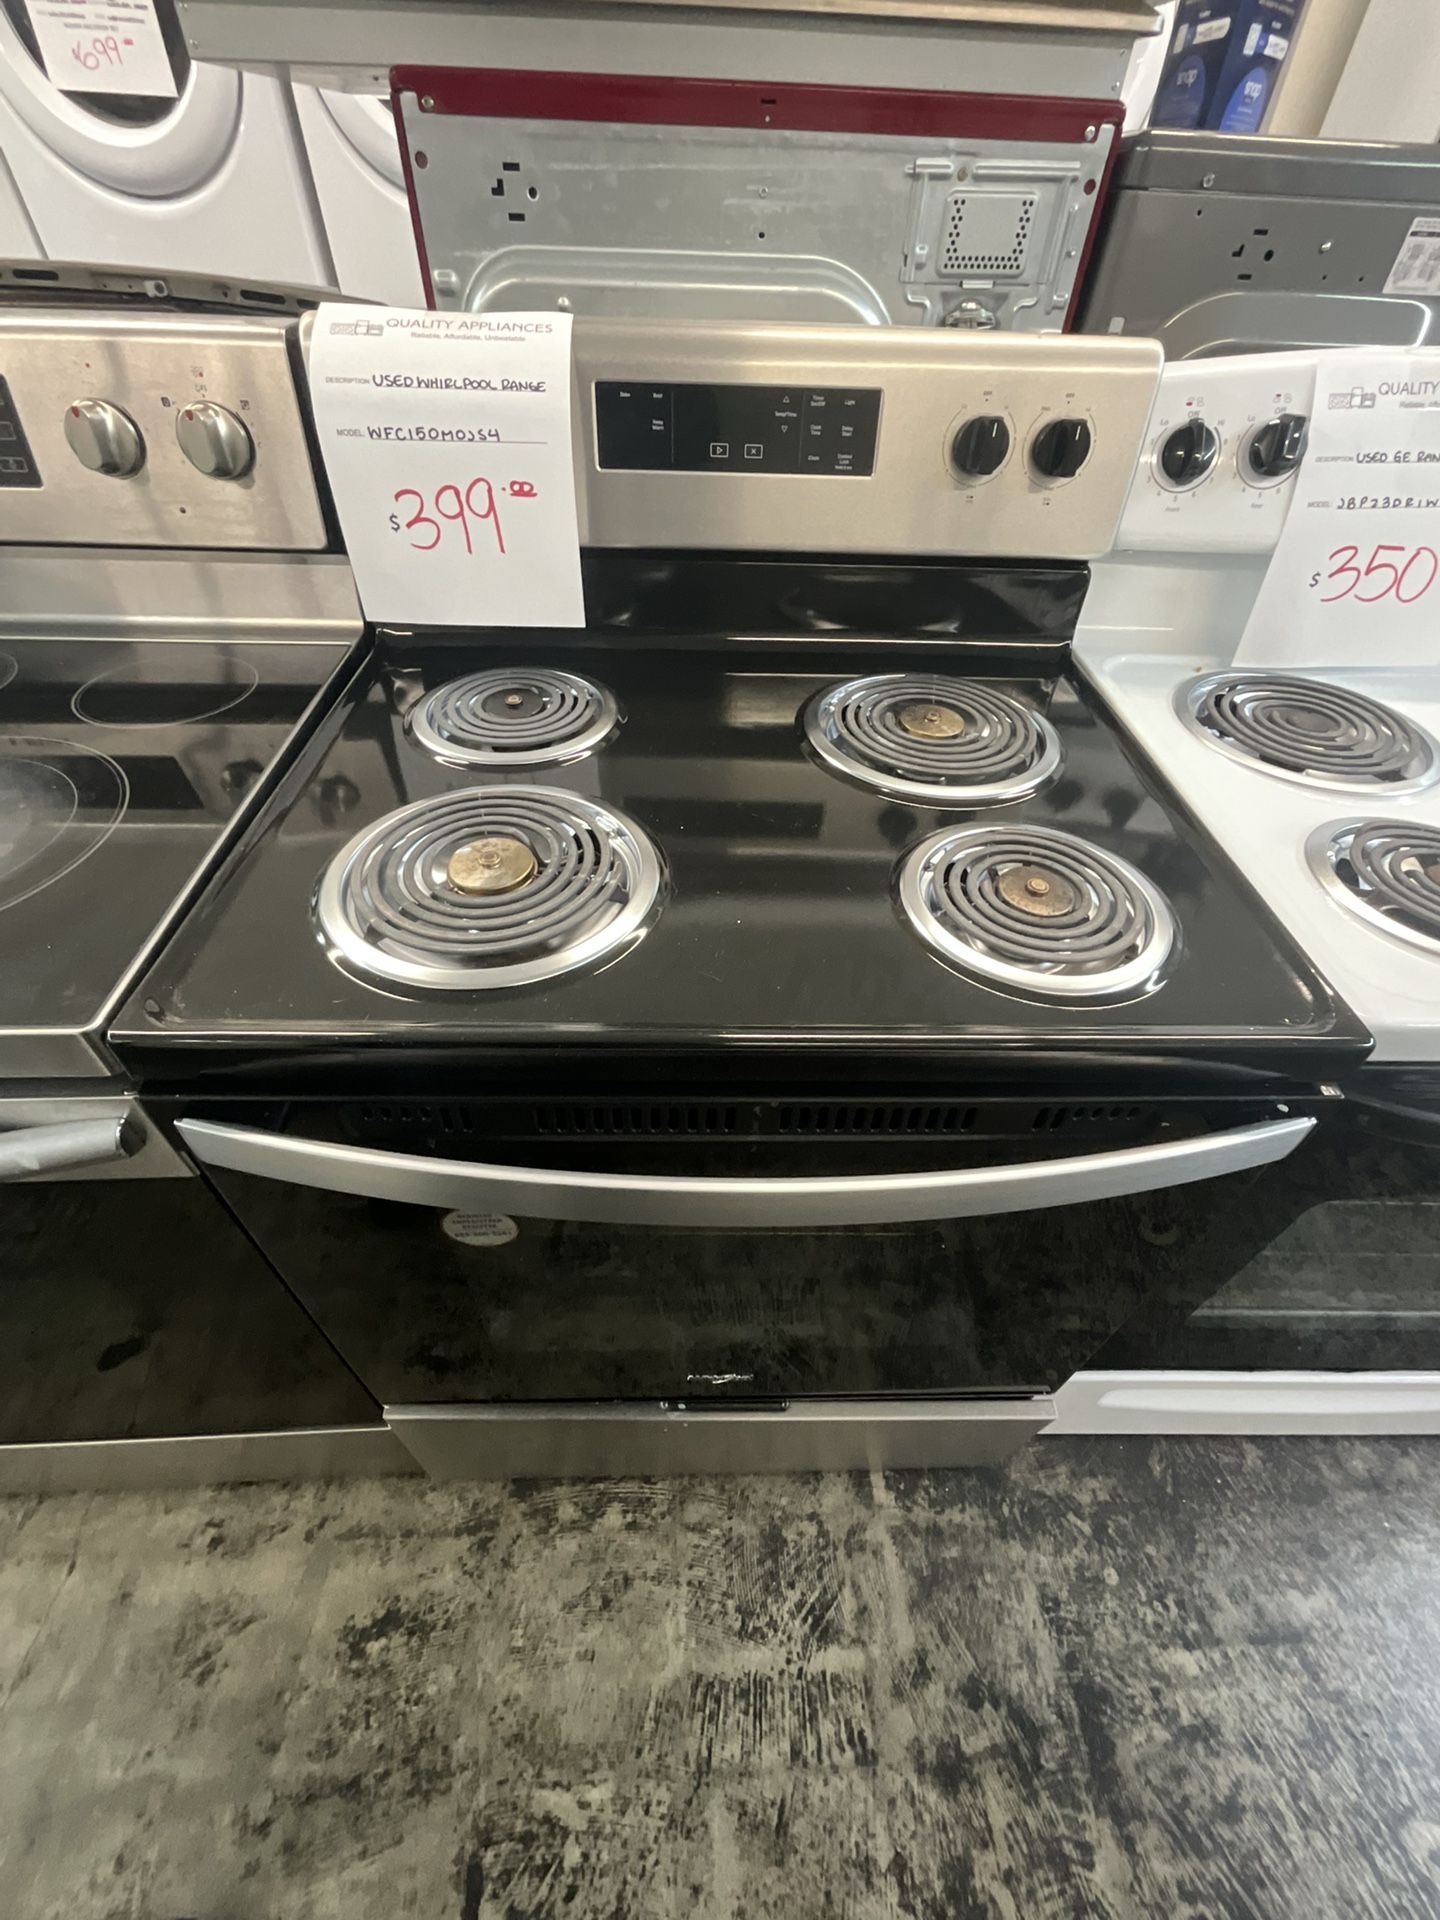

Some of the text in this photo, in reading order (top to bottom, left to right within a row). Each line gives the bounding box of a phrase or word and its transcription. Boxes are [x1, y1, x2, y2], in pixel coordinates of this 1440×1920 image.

[386, 317, 553, 334] QUALITY APPLIANCES
[372, 374, 414, 388] USED
[417, 377, 499, 391] WHIRLPOOL
[501, 379, 546, 392] RANGE
[1378, 381, 1440, 396] QUALITY
[1356, 451, 1388, 464] USED
[1394, 451, 1411, 464] GE
